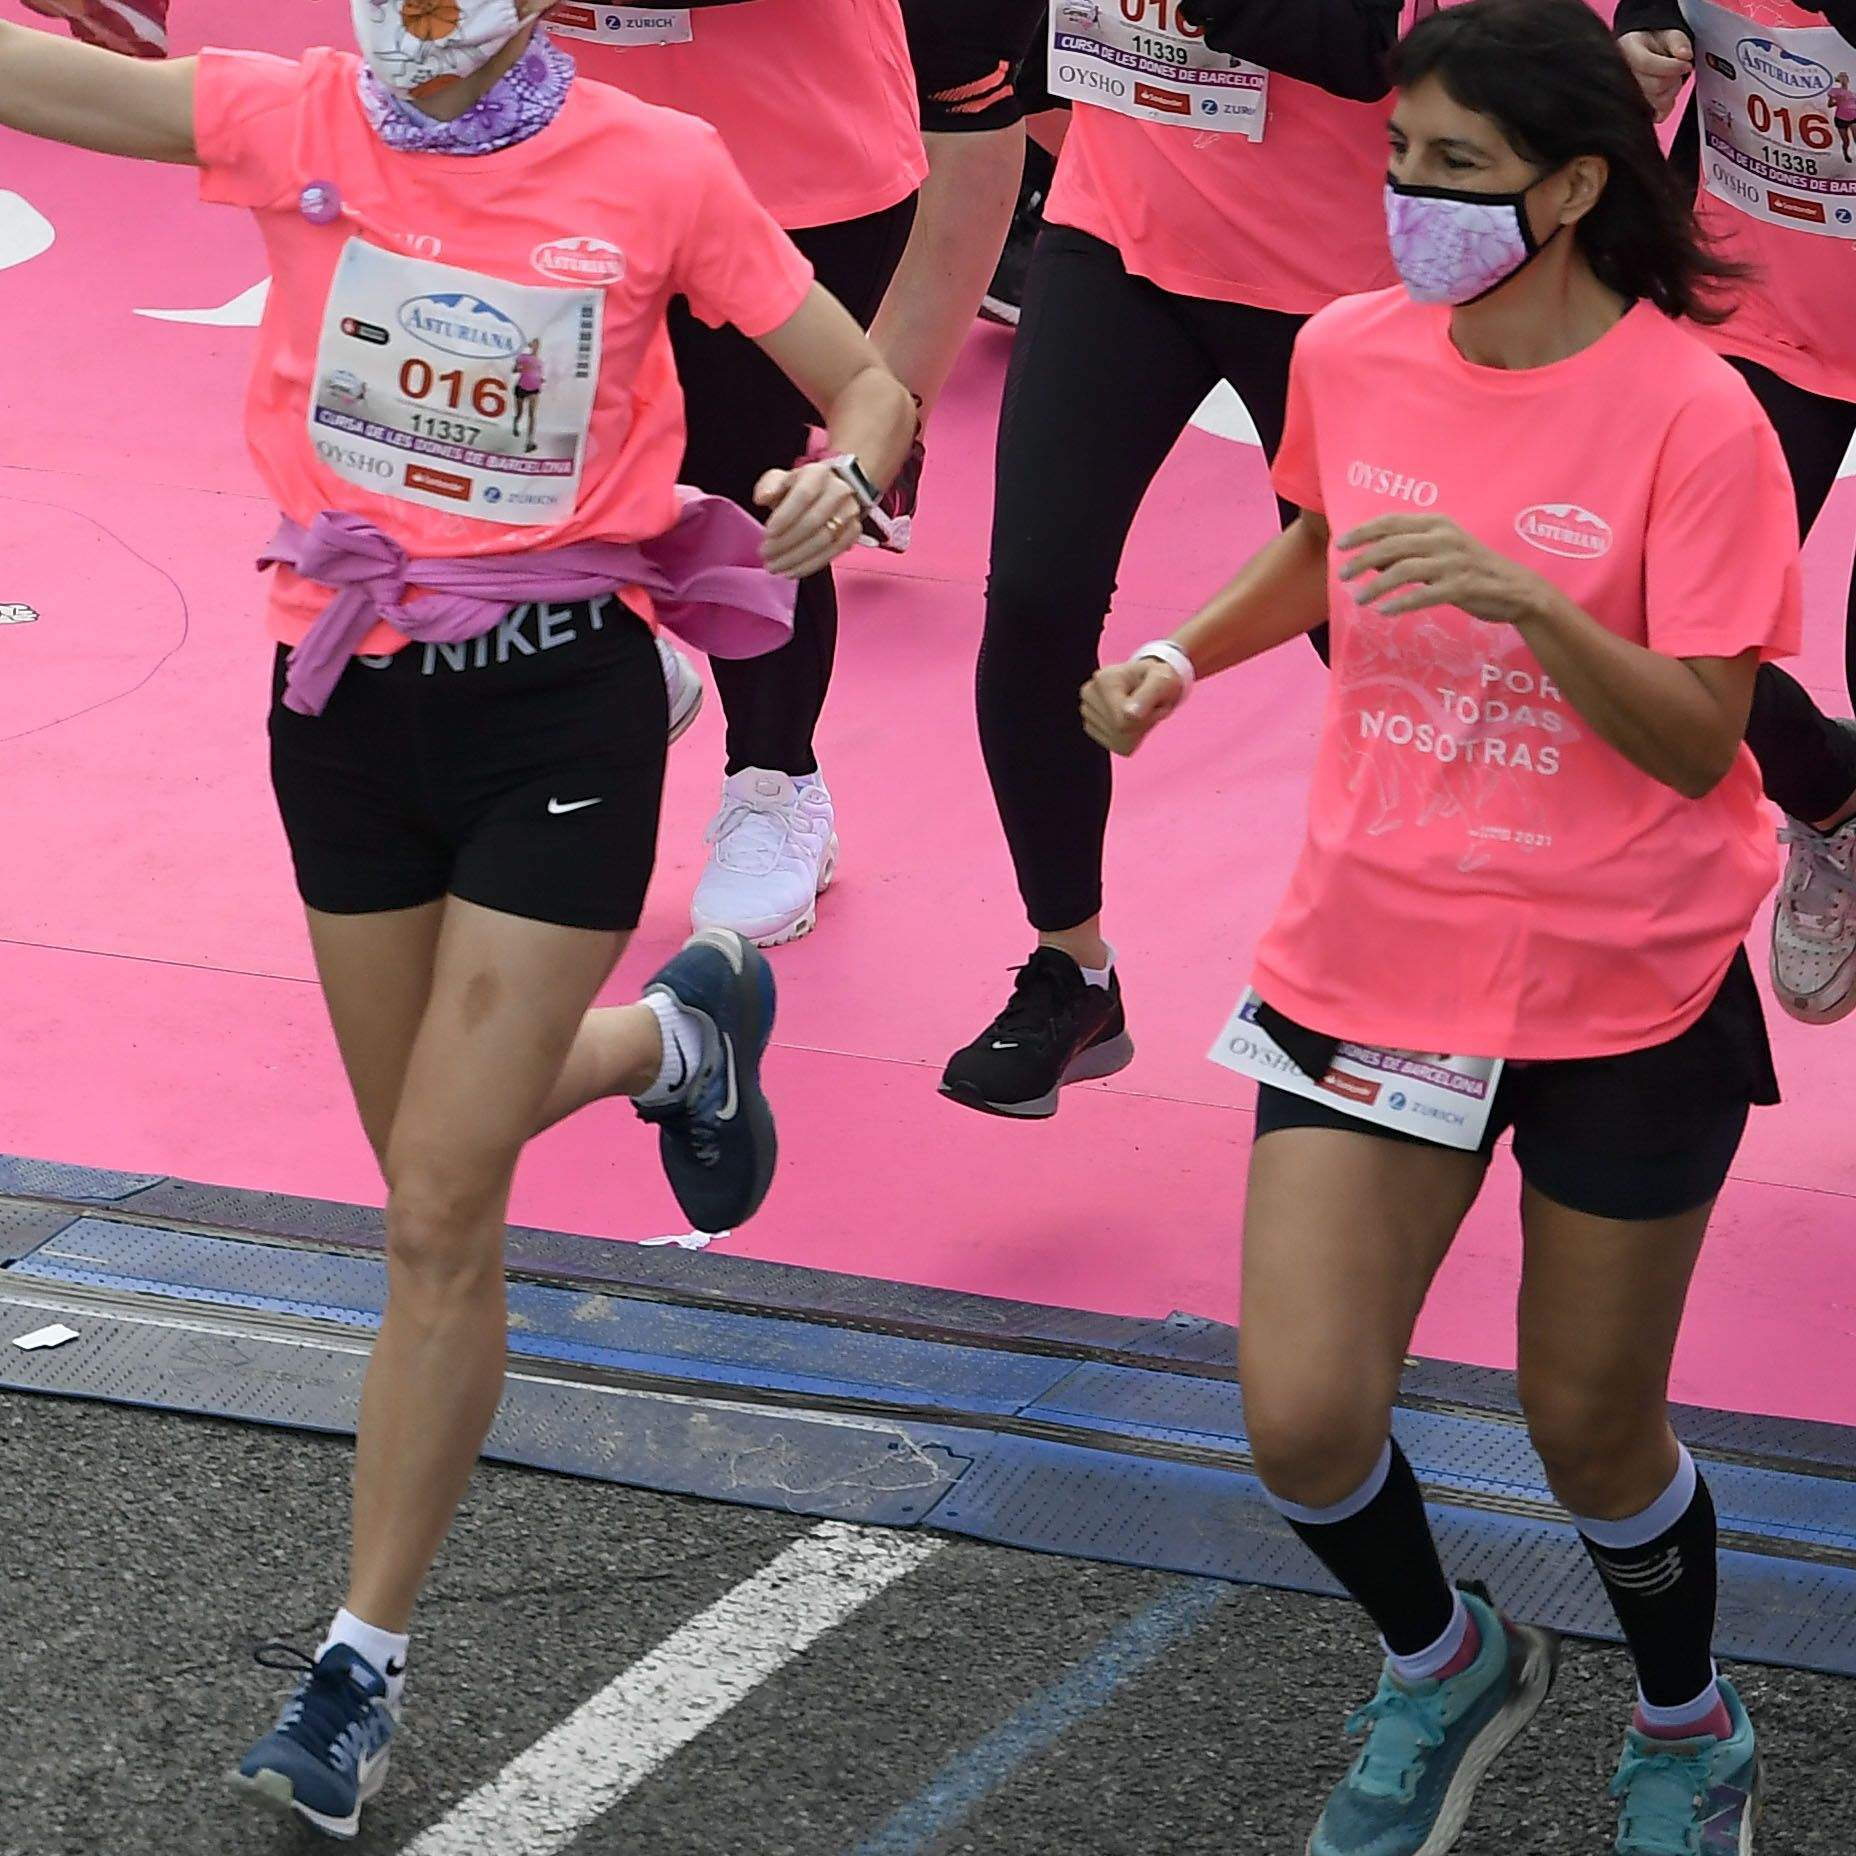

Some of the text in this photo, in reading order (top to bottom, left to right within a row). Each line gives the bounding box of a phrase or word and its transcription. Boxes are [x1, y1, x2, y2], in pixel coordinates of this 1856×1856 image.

[626, 16, 673, 30] ZURICH
[1060, 34, 1266, 90] CURSA DE LES DONES DE BARCELON
[1132, 34, 1188, 66] 11339
[1059, 65, 1126, 98] OYSHO
[1741, 51, 1826, 90] ASTURIANA
[1745, 93, 1835, 151] 016
[1736, 153, 1750, 170] DE
[1750, 158, 1768, 179] LES
[1770, 164, 1808, 190] DONES
[1809, 176, 1828, 192] DE
[1761, 144, 1819, 177] 11338
[1712, 163, 1759, 204] OYSHO
[409, 308, 514, 351] ASTURIANA
[398, 357, 508, 418] 016
[411, 413, 481, 445] 11337
[316, 440, 394, 479] OYSHO
[1346, 459, 1439, 508] OYSHO
[1436, 686, 1564, 734] TODAS
[1359, 708, 1561, 777] NOSOTRAS
[1411, 1102, 1466, 1127] ZURICH
